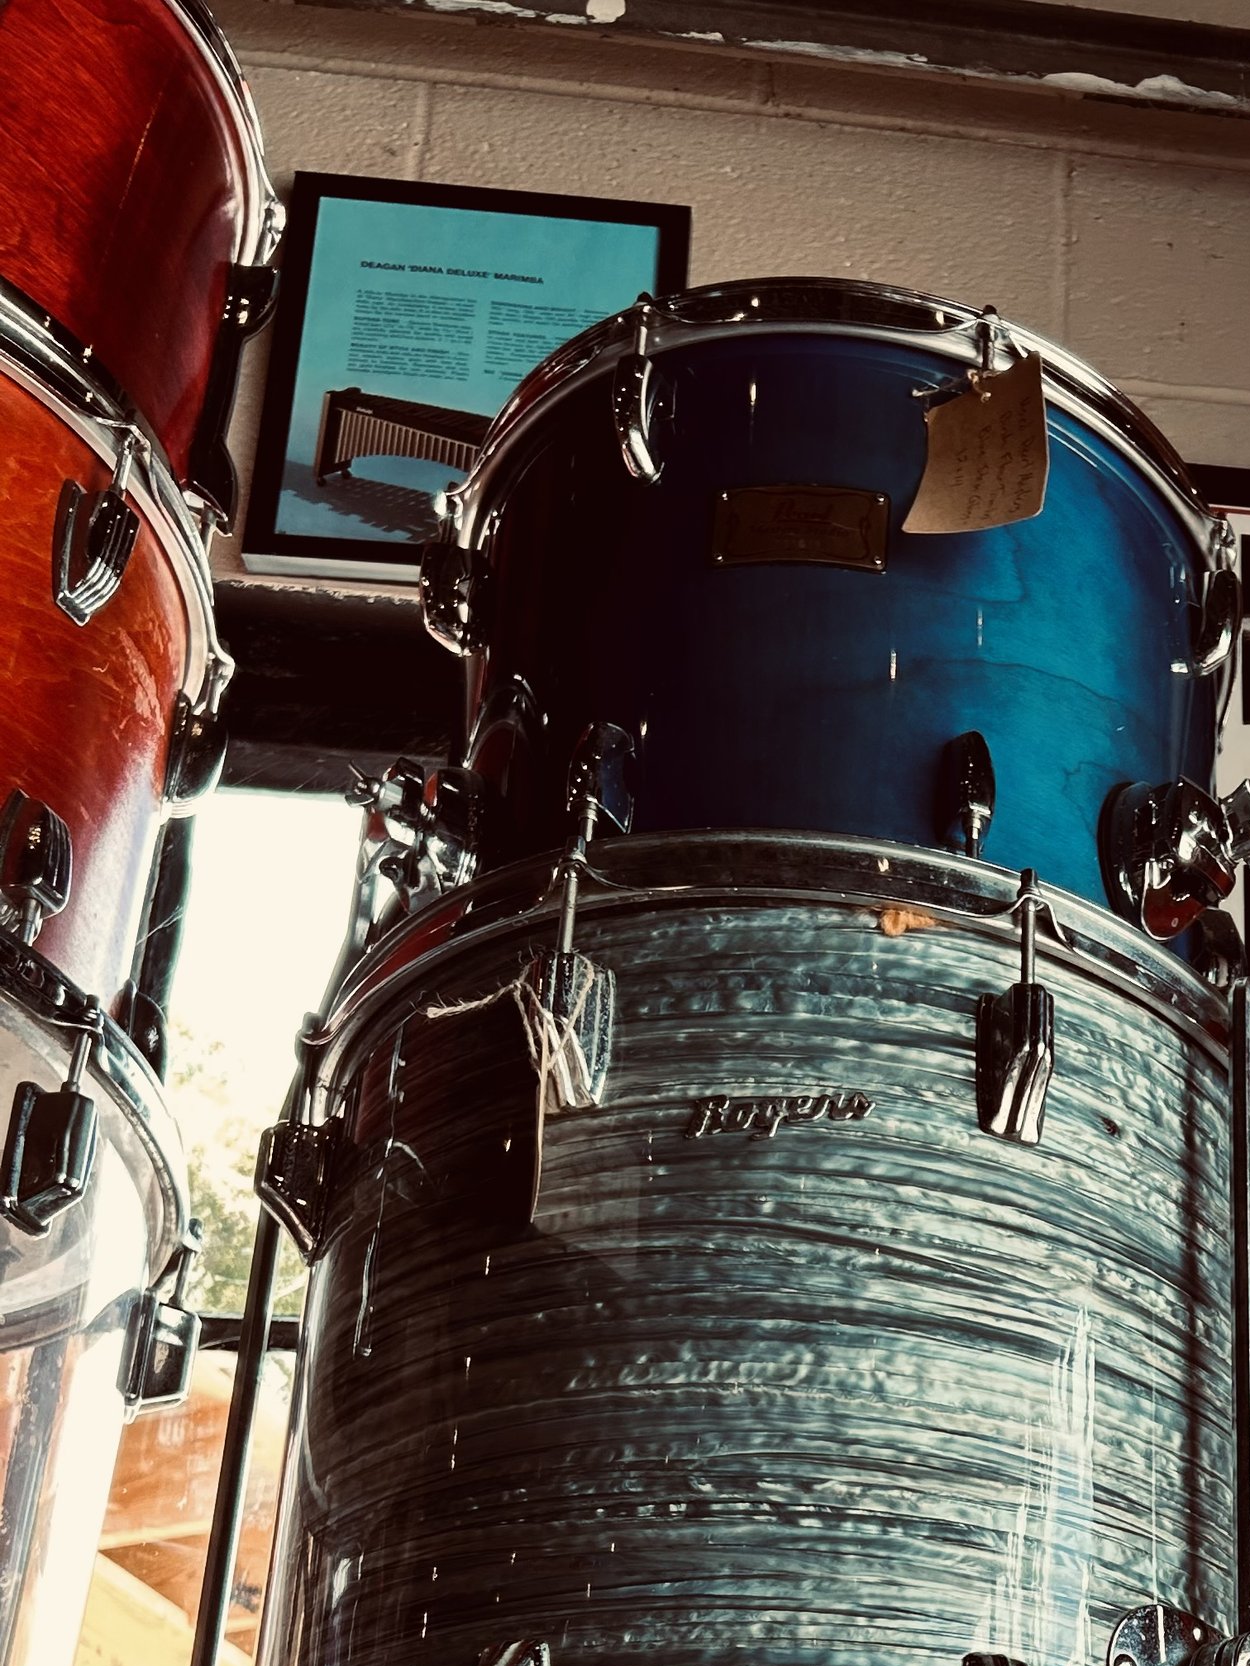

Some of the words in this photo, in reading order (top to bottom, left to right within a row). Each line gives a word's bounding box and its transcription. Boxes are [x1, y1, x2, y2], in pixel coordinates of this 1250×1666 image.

[361, 260, 406, 272] DEAGAN
[494, 272, 545, 285] MARIMBA
[684, 1092, 876, 1141] Rogers
